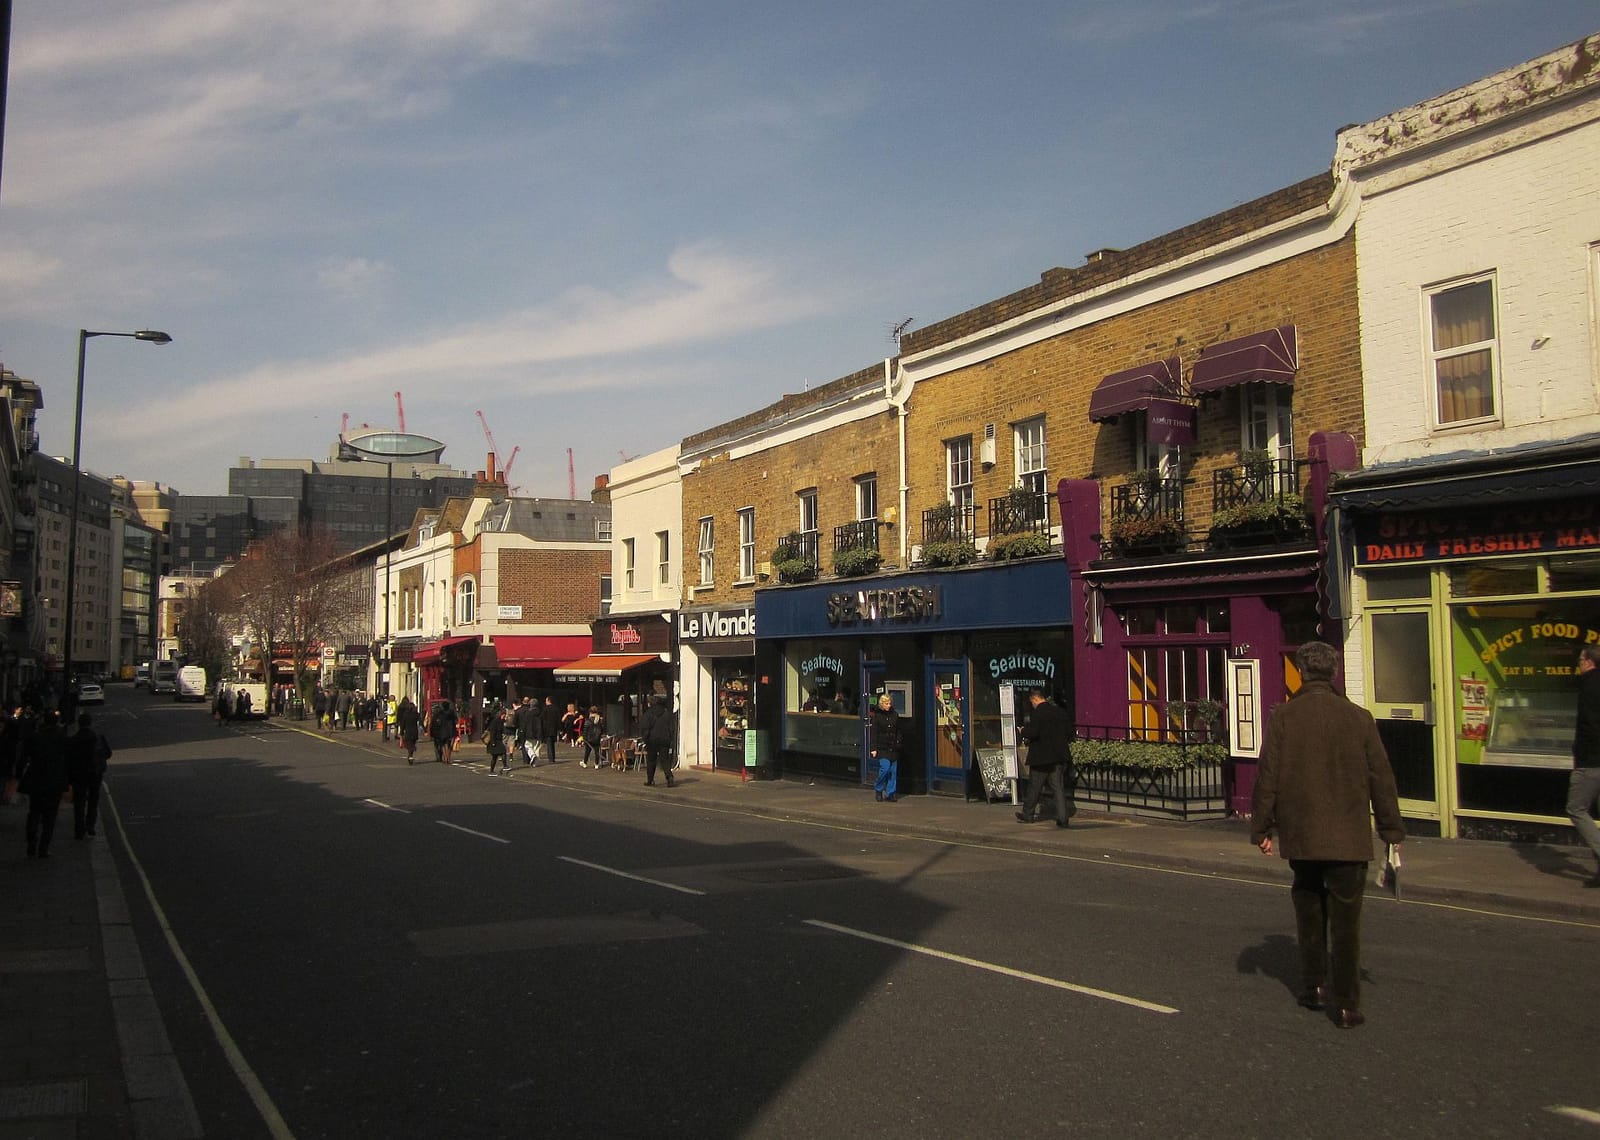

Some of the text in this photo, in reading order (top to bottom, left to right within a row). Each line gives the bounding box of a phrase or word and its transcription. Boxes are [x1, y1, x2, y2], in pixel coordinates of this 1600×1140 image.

[1366, 527, 1600, 562] DAILY FRESHLY MA
[827, 585, 942, 624] SEAFRESH
[679, 608, 756, 638] Le Monde
[1481, 628, 1524, 664] SPICY
[1531, 623, 1579, 639] FOOD
[801, 652, 844, 676] Seafresh
[990, 649, 1055, 678] Seafresh
[1503, 666, 1520, 675] EAT
[1522, 666, 1534, 675] IN
[1544, 666, 1572, 675] TAKE
